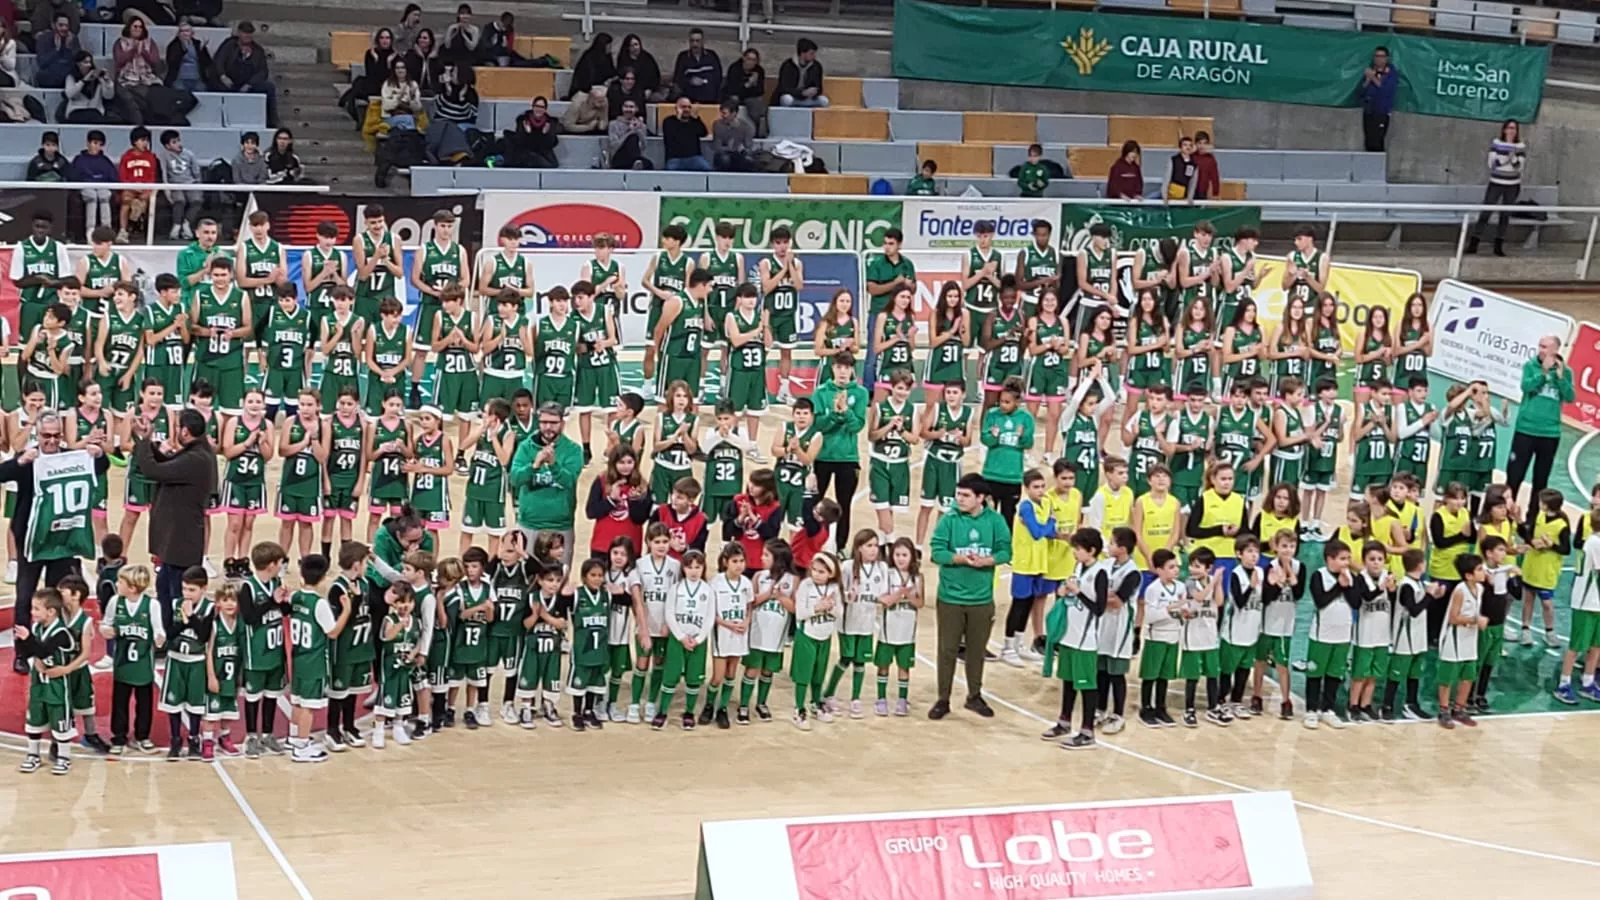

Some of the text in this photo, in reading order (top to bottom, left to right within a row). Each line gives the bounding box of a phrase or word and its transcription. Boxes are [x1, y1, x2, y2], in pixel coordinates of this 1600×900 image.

[1121, 36, 1268, 64] CAJA RURAL
[1136, 63, 1250, 84] DE ARAGÓN
[1474, 63, 1510, 84] San
[1436, 78, 1510, 101] Lorenzo
[370, 272, 386, 290] 17
[977, 284, 993, 302] 14
[166, 346, 182, 365] 18
[280, 348, 293, 368] 3
[503, 354, 516, 371] 2
[742, 348, 762, 368] 33
[891, 347, 908, 362] 33
[942, 345, 958, 362] 31
[1145, 353, 1159, 368] 16
[1405, 354, 1424, 371] 00
[333, 358, 353, 376] 28
[444, 354, 467, 372] 20
[544, 357, 566, 374] 99
[1191, 358, 1207, 373] 15
[1241, 359, 1256, 375] 13
[1287, 359, 1301, 374] 12
[1371, 364, 1382, 380] 5
[1369, 441, 1385, 459] 10
[1412, 443, 1428, 462] 31
[1459, 440, 1468, 455] 3
[237, 456, 258, 475] 34
[295, 458, 307, 475] 8
[336, 453, 356, 470] 49
[382, 457, 399, 475] 14
[1077, 449, 1095, 469] 41
[716, 463, 736, 480] 32
[416, 474, 433, 489] 28
[46, 480, 90, 515] 10
[500, 603, 517, 621] 17
[289, 618, 313, 649] 88
[465, 627, 481, 646] 13
[591, 631, 599, 650] 1
[127, 642, 138, 661] 6
[537, 638, 554, 653] 10
[225, 662, 234, 681] 9
[885, 819, 1155, 870] GRUPO Lobe
[990, 866, 1142, 890] HIGH QUALITY HOMES
